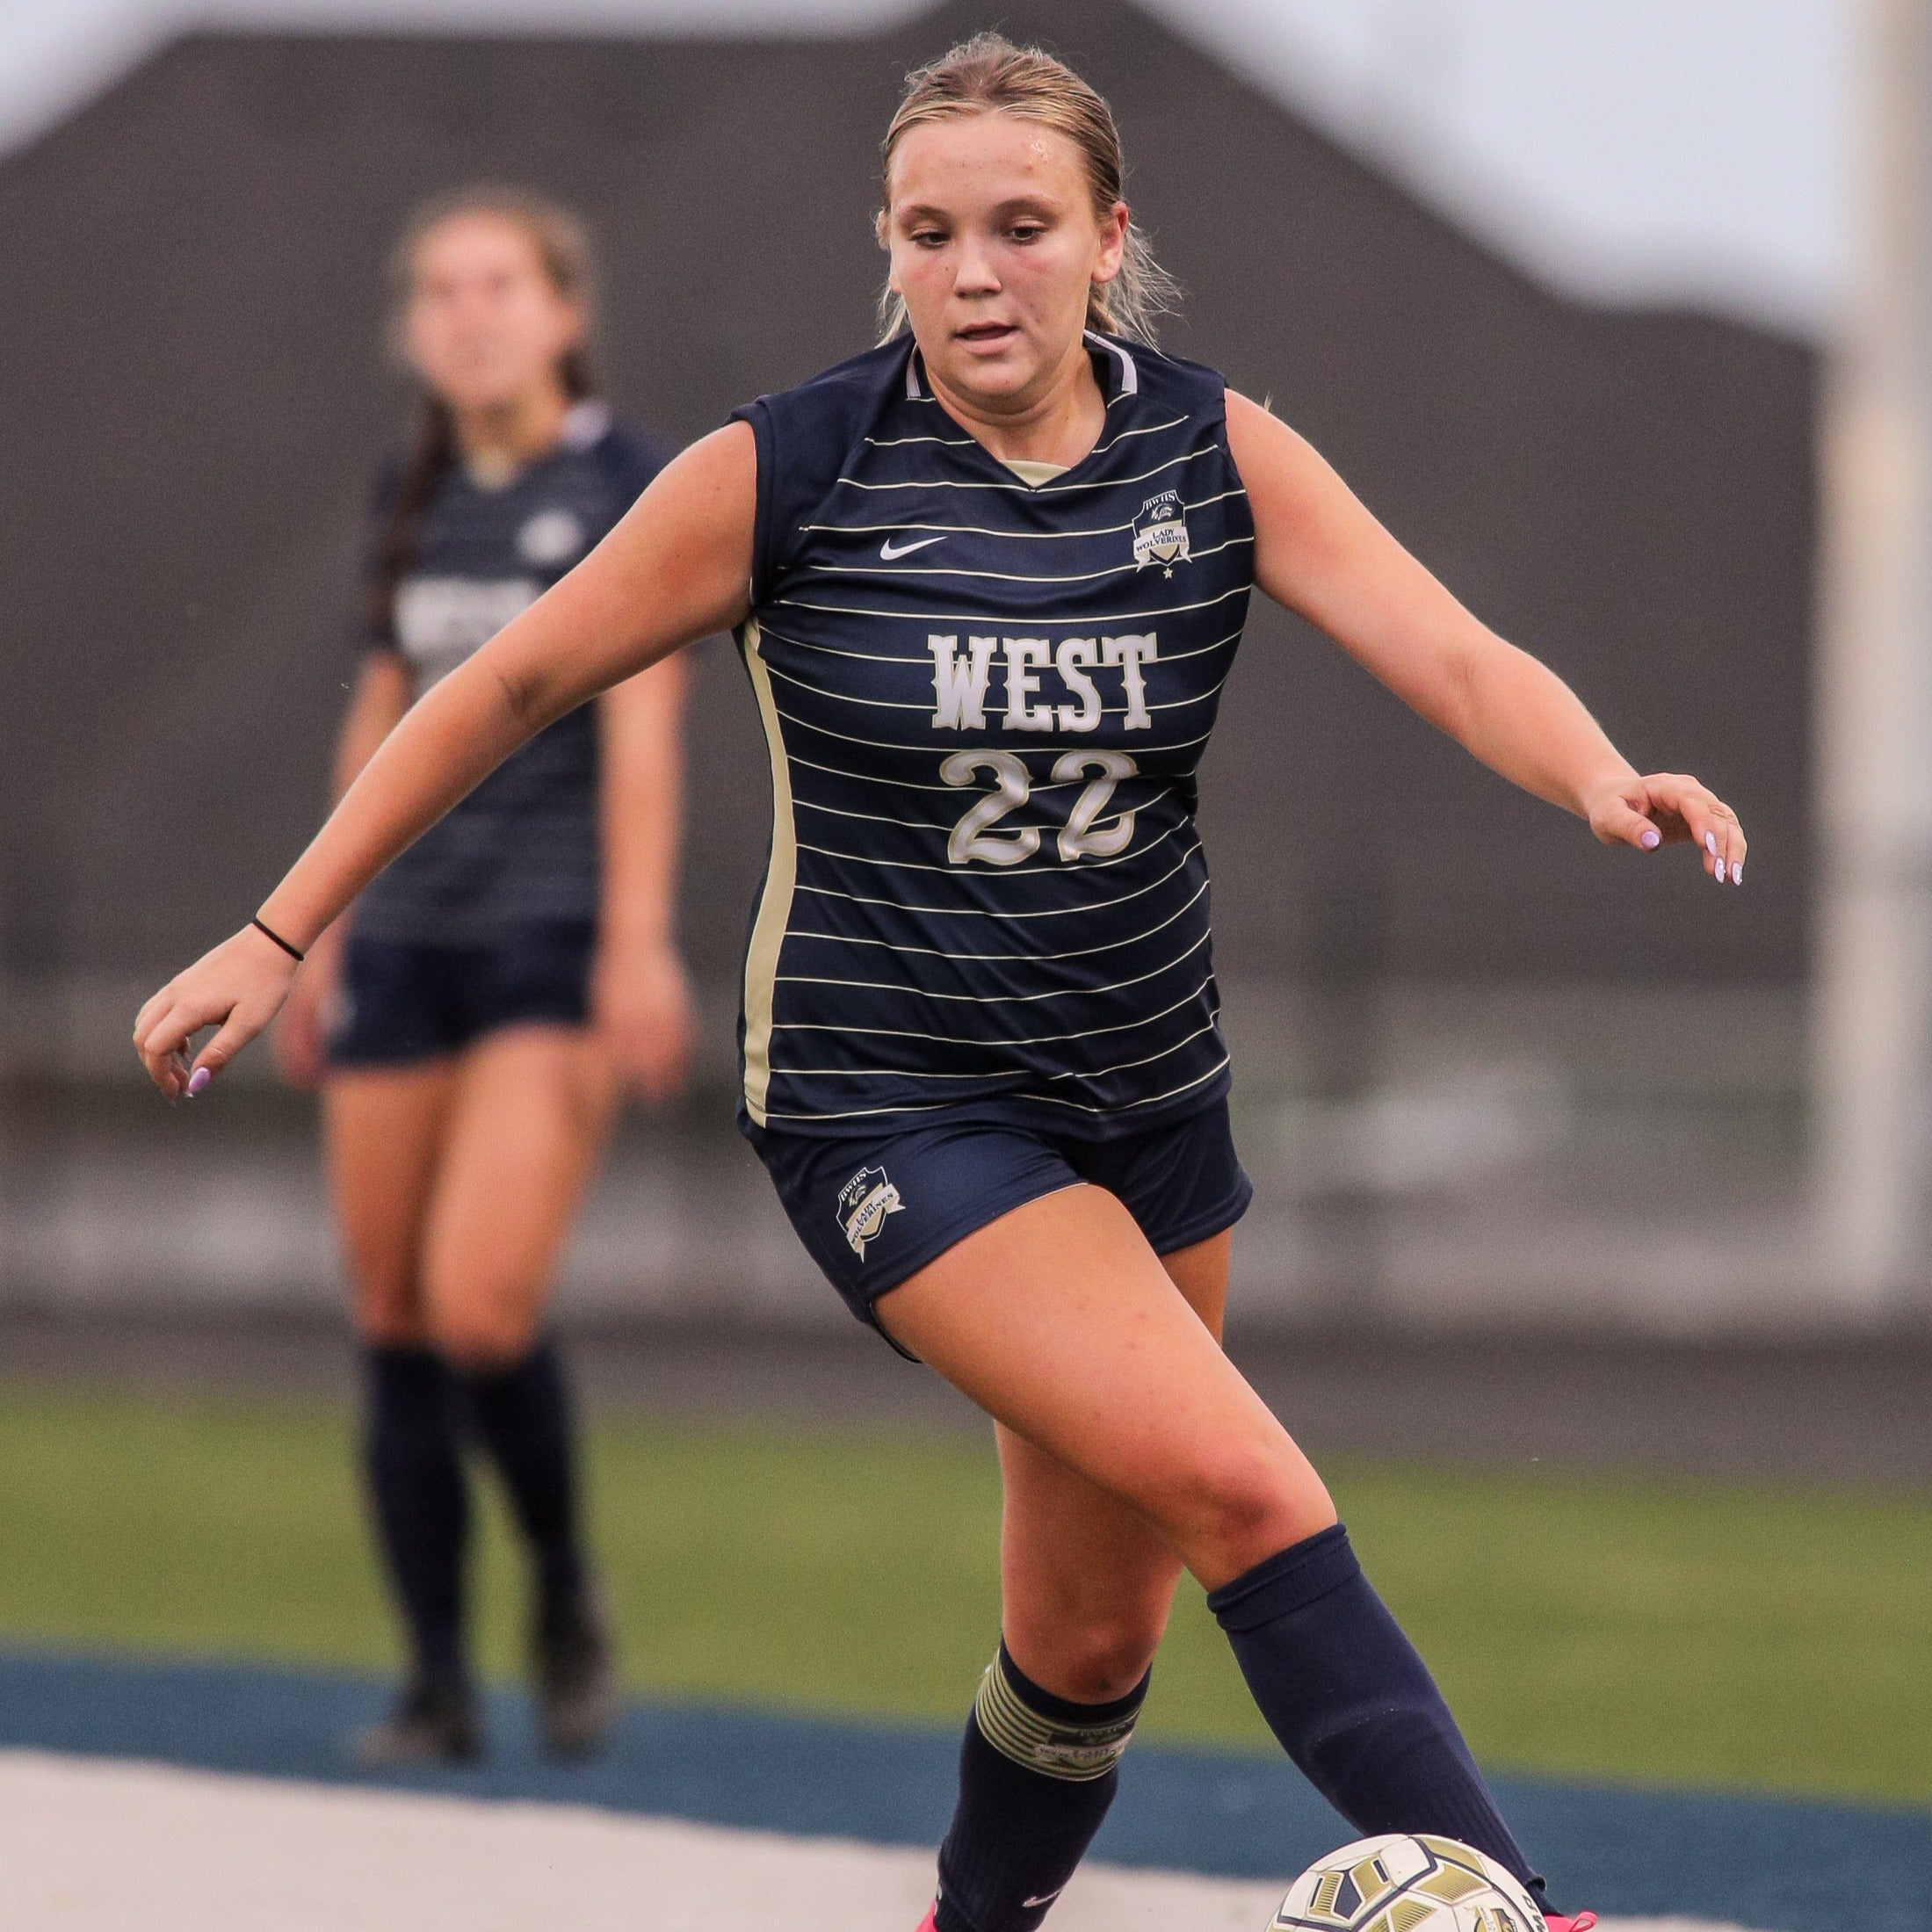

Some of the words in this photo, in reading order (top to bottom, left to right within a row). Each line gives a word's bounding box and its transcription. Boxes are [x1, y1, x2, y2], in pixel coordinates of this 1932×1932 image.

[1136, 535, 1186, 552] WOLVERINES
[1153, 528, 1175, 539] LADY
[927, 632, 1158, 732] WEST
[938, 749, 1140, 866] 22
[850, 1191, 894, 1245] WOLVERINES
[857, 1200, 874, 1223] LADY
